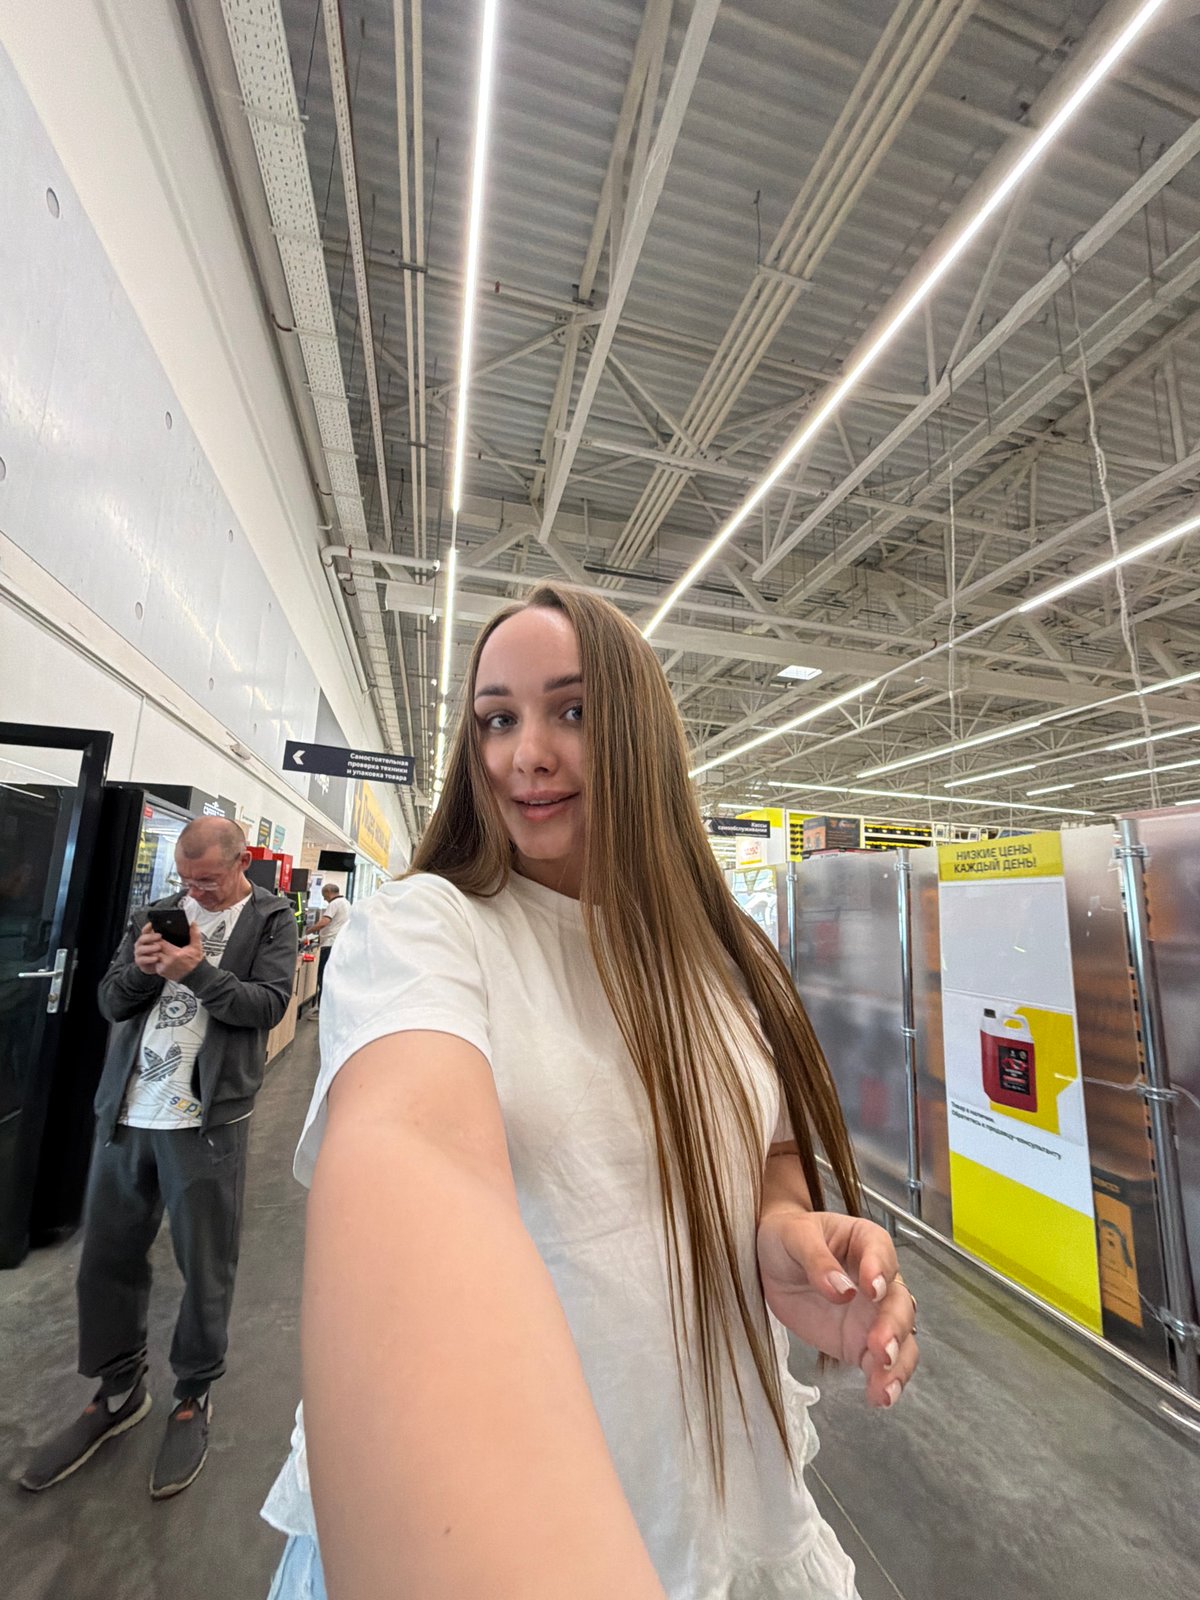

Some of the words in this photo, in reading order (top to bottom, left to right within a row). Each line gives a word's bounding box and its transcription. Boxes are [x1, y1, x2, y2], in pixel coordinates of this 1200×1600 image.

[350, 753, 409, 766] Самостоятельная
[347, 761, 380, 770] проверка
[380, 765, 408, 773] техники
[352, 770, 384, 778] упаковка
[385, 773, 407, 782] товара
[956, 847, 997, 861] НИЗКИЕ
[999, 843, 1032, 858] ЦЕНЫ
[954, 859, 1000, 873] КАЖДЫЙ
[1003, 857, 1037, 871] ДЕНЬ!
